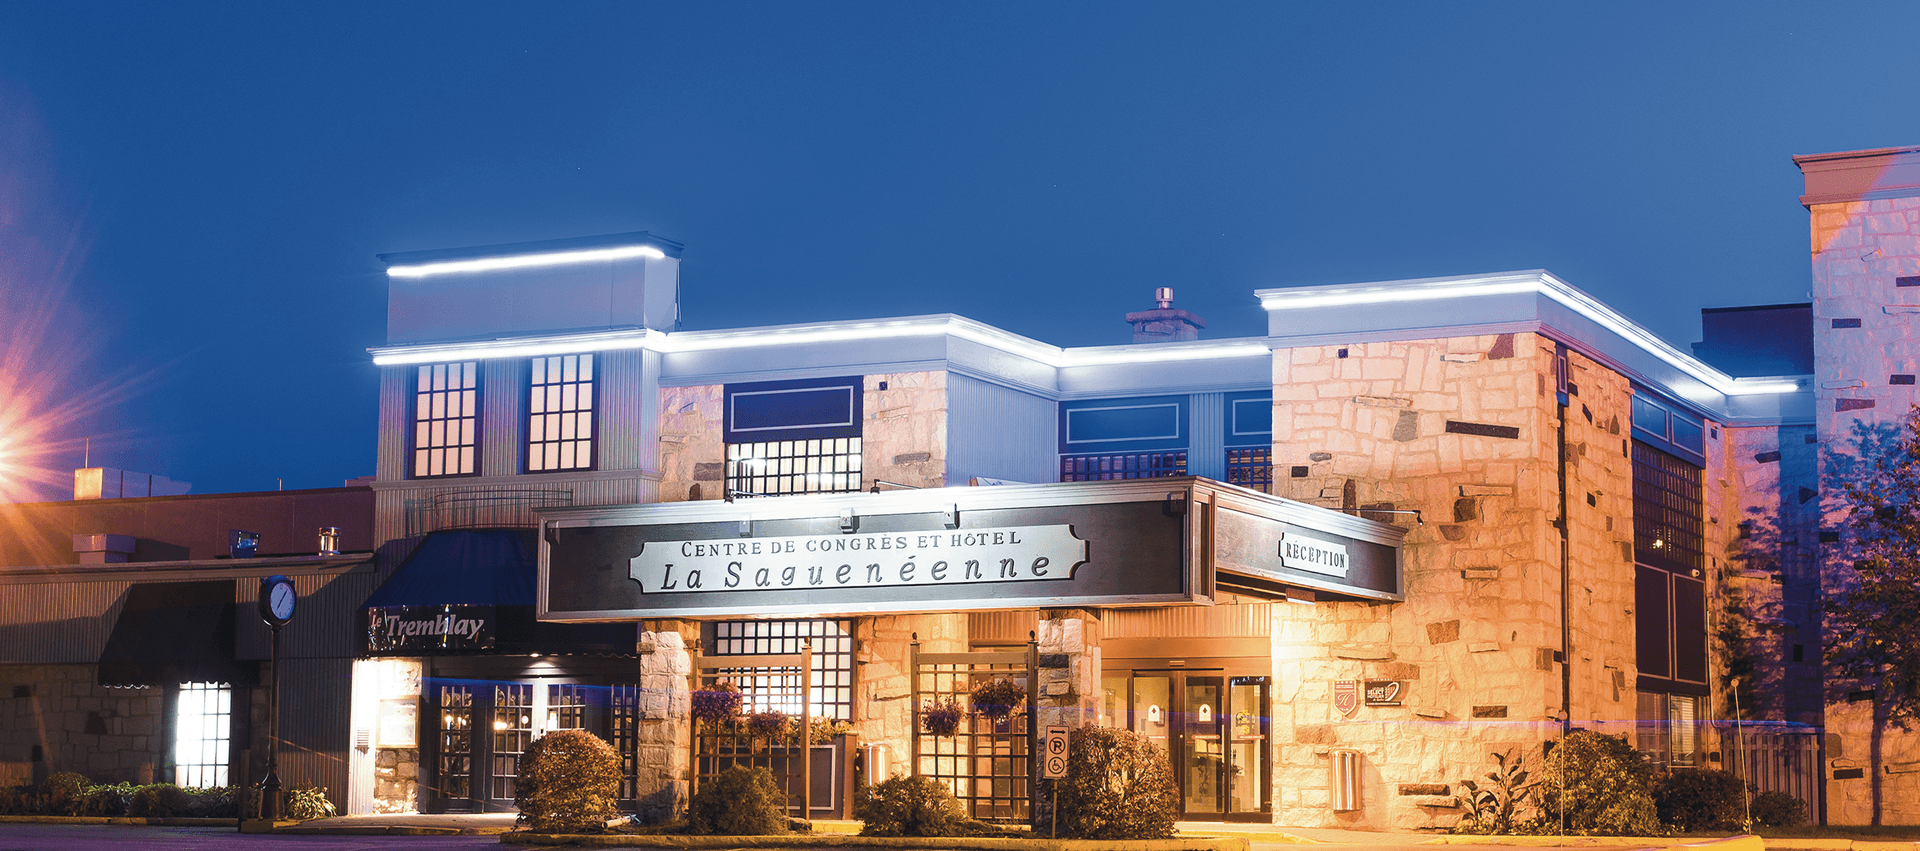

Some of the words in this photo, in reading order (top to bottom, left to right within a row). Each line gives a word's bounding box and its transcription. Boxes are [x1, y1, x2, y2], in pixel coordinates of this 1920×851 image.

[681, 541, 762, 557] CENTRE
[771, 540, 796, 554] DE
[806, 534, 908, 553] CONGRÈS
[917, 535, 942, 549] ET
[950, 531, 1022, 547] HÔTEL
[1286, 540, 1345, 568] RÉCEPTION
[660, 563, 703, 590] La
[724, 555, 1050, 589] Saguenéenne
[371, 614, 383, 628] Le
[386, 614, 485, 640] Tremblay
